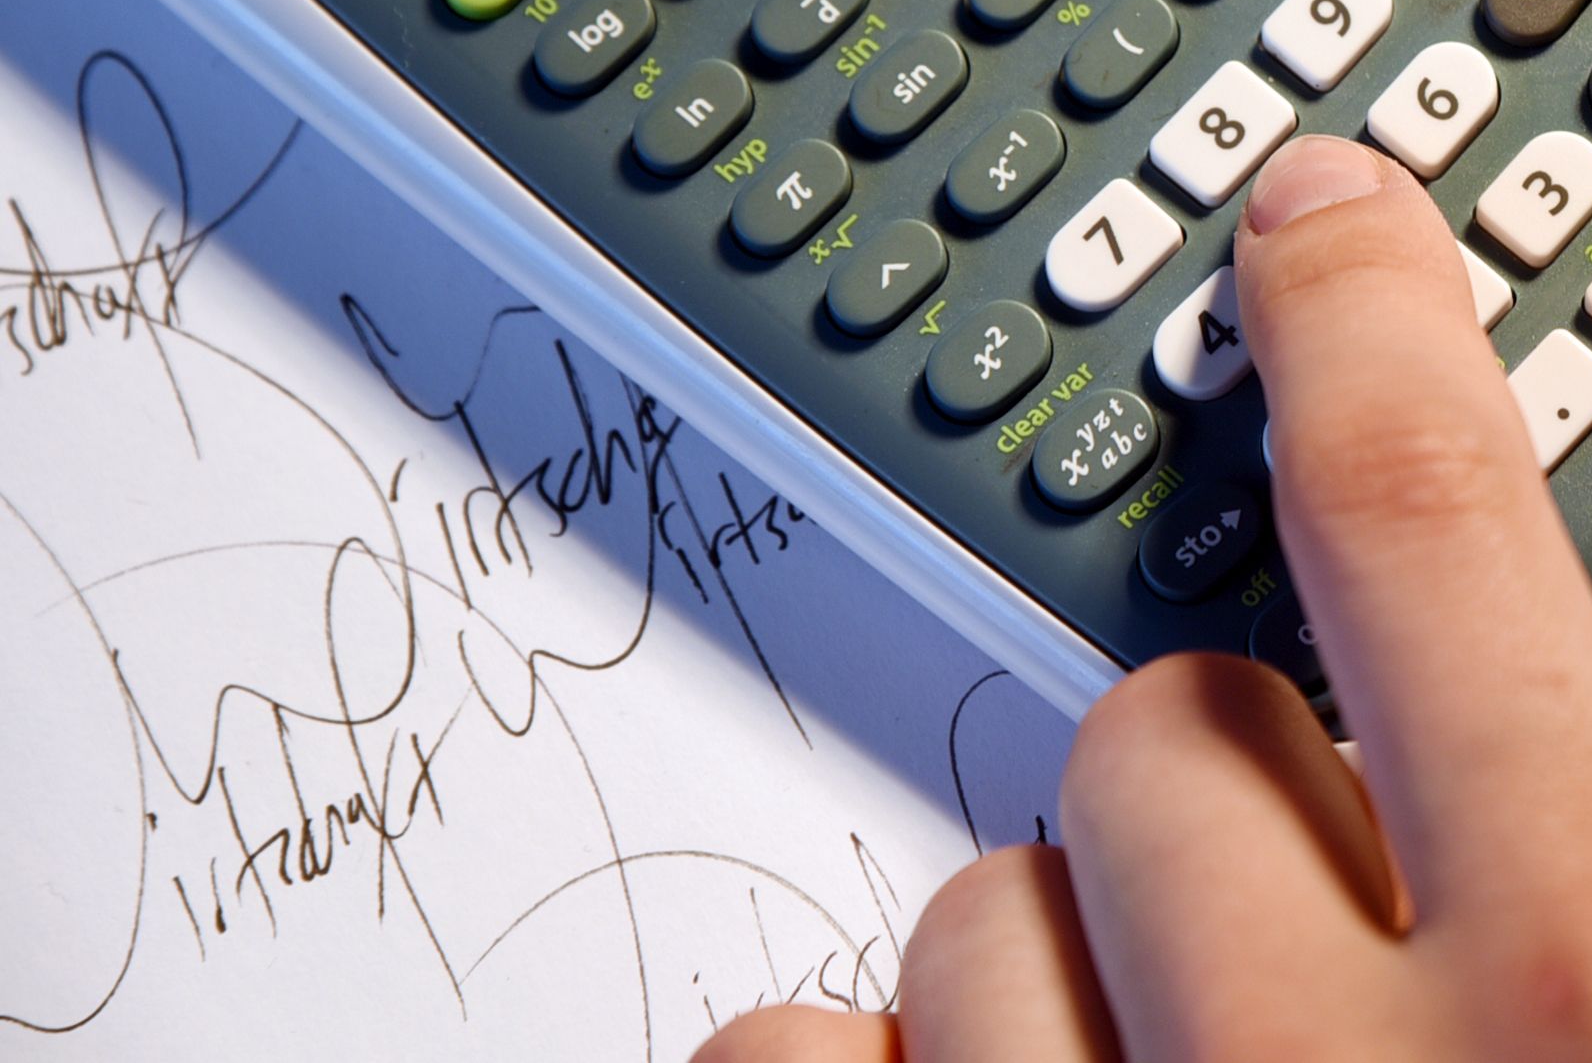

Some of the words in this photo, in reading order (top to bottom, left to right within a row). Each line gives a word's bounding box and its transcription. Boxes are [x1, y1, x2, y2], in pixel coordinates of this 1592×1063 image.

[567, 8, 625, 54] log
[1056, 0, 1093, 27] %
[893, 63, 938, 105] sin
[1416, 76, 1460, 121] 6
[675, 96, 716, 129] ln
[1198, 106, 1247, 151] 8
[713, 137, 769, 184] hyp
[1521, 169, 1571, 217] 3
[1081, 215, 1126, 267] 7
[1197, 309, 1240, 356] 4
[996, 396, 1055, 456] clear
[1051, 361, 1095, 404] var
[1116, 464, 1185, 530] recall
[1174, 523, 1224, 569] sto
[1241, 568, 1278, 607] off
